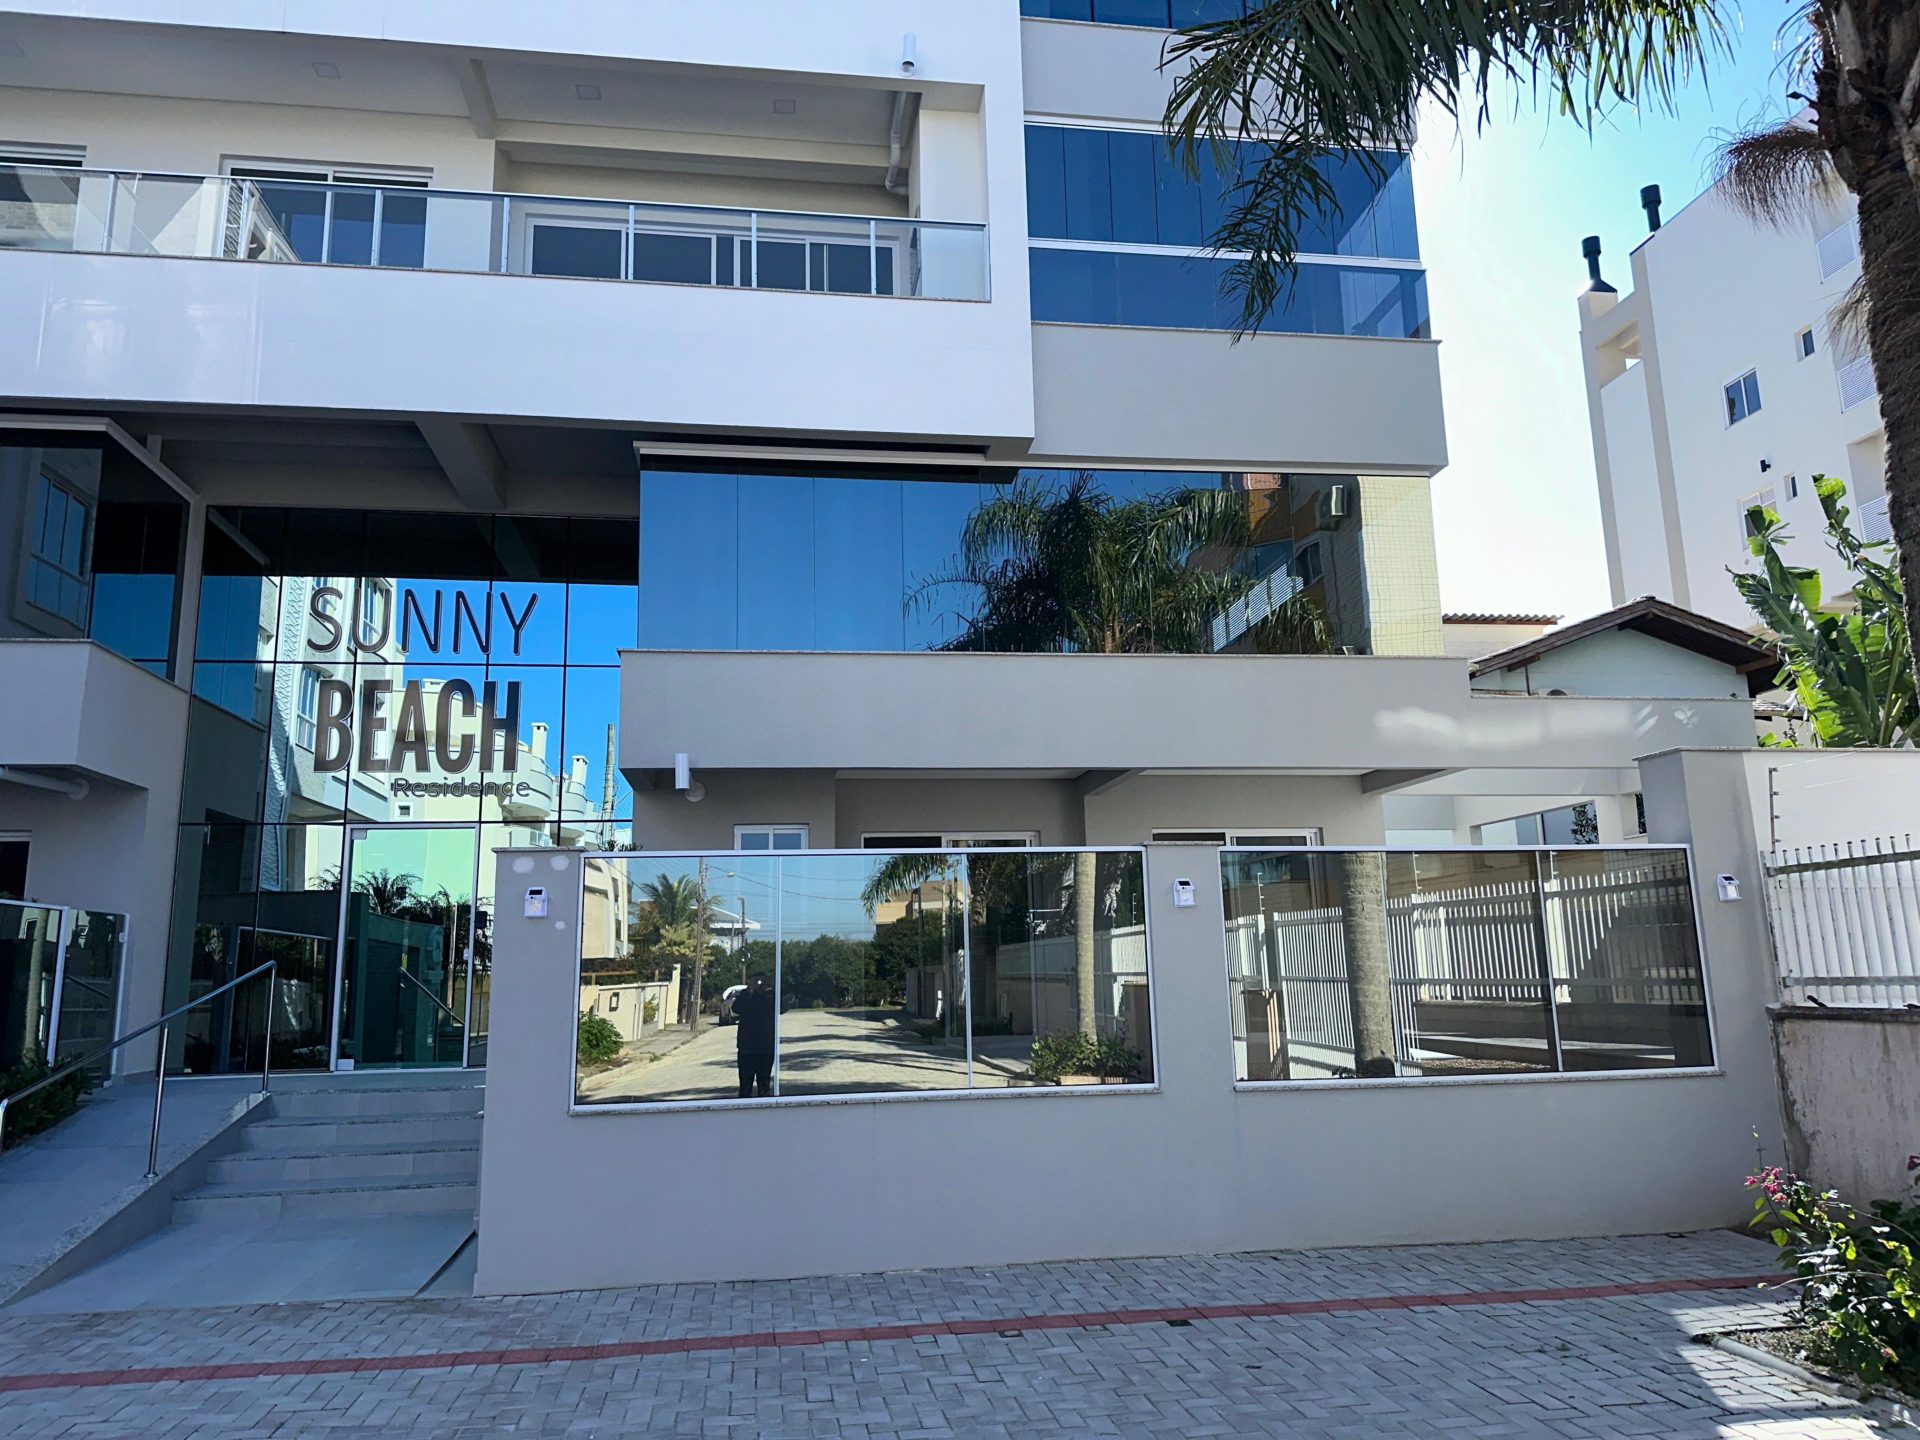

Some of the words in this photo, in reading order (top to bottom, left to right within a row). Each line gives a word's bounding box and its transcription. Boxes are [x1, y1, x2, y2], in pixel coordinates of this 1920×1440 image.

[307, 586, 539, 656] SUNNY
[313, 678, 522, 774] BEACH
[392, 776, 531, 798] Residence
